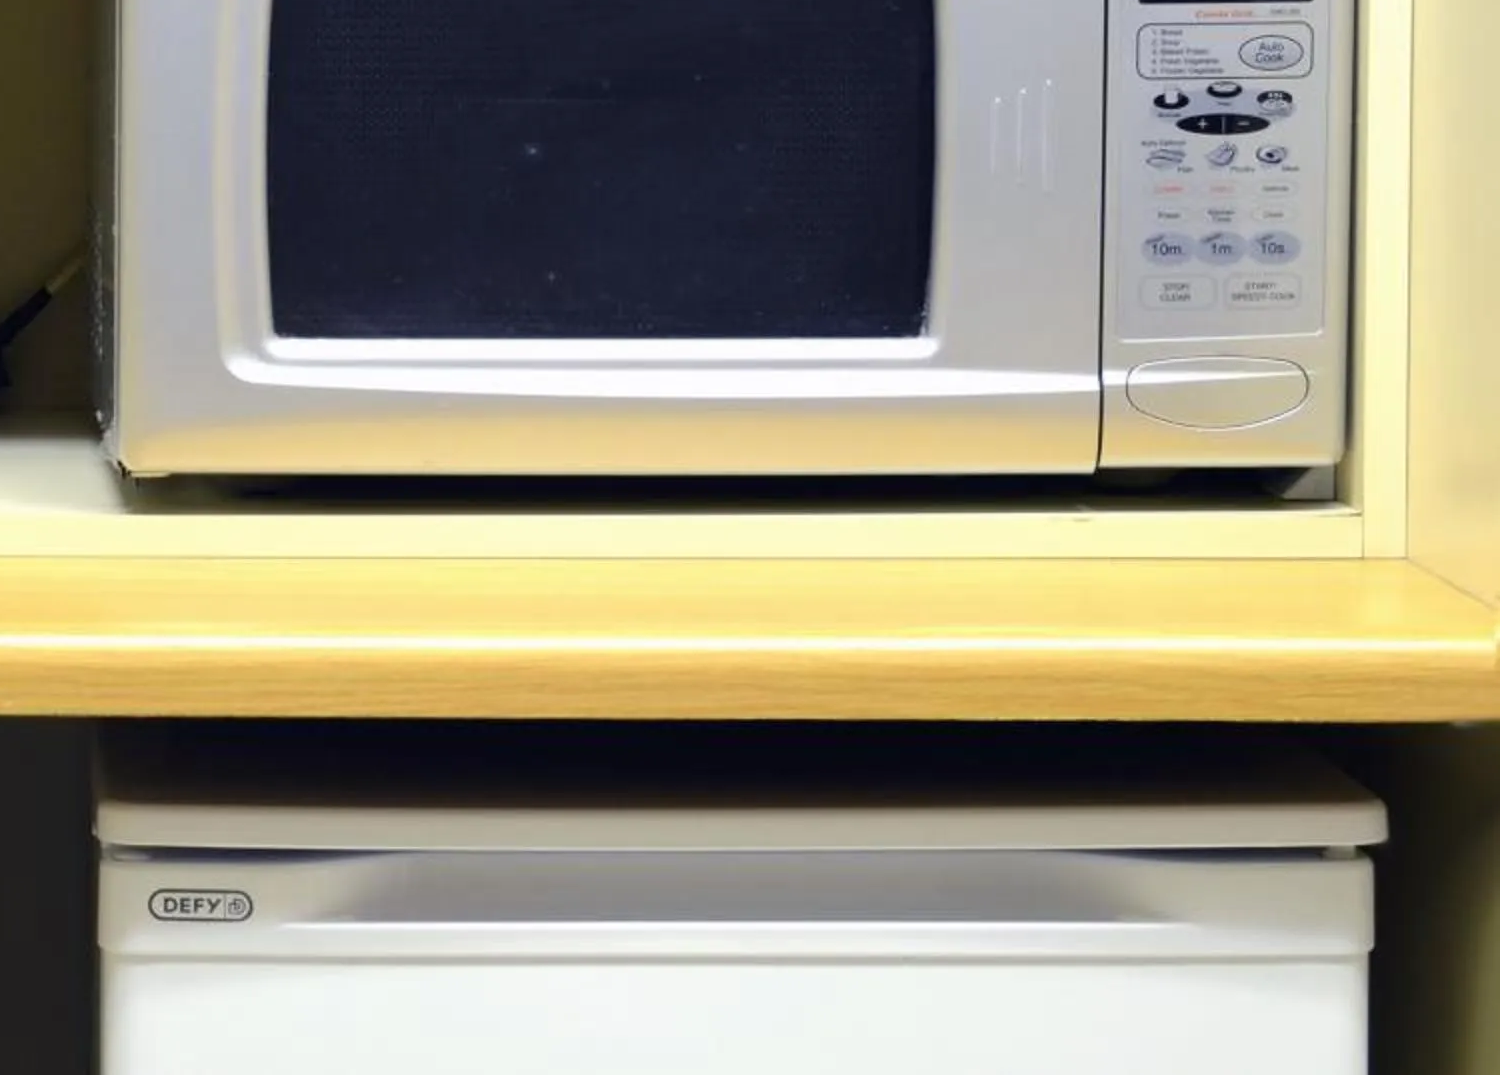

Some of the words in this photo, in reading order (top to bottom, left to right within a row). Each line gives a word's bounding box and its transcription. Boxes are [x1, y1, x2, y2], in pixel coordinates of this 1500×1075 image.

[1258, 42, 1285, 52] Auto
[1255, 53, 1284, 63] Cook
[163, 896, 222, 914] DEFY
